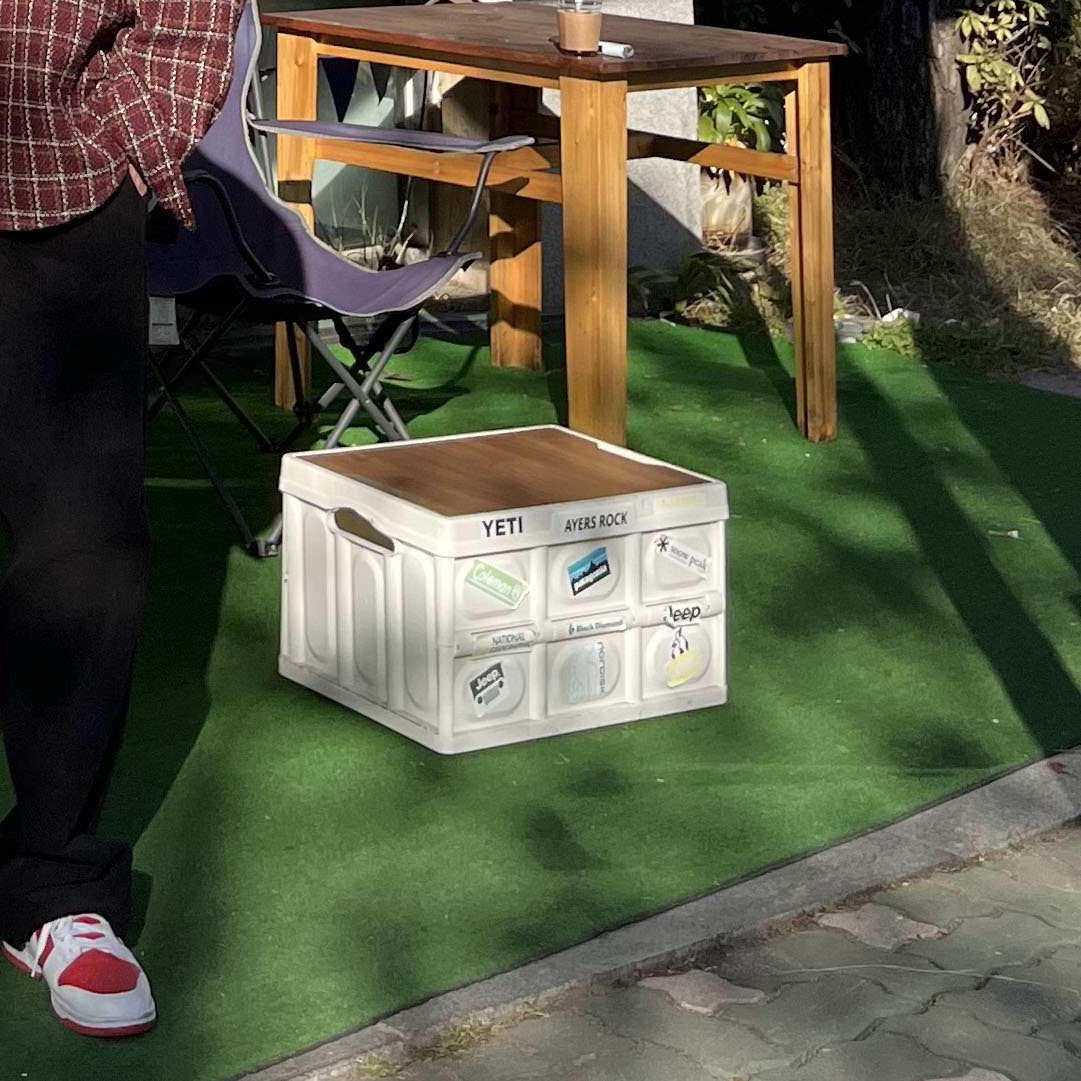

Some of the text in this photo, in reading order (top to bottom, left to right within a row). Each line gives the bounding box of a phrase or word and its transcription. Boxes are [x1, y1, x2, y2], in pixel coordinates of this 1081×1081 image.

[482, 516, 524, 538] YETI
[564, 511, 628, 533] AYERS ROCK
